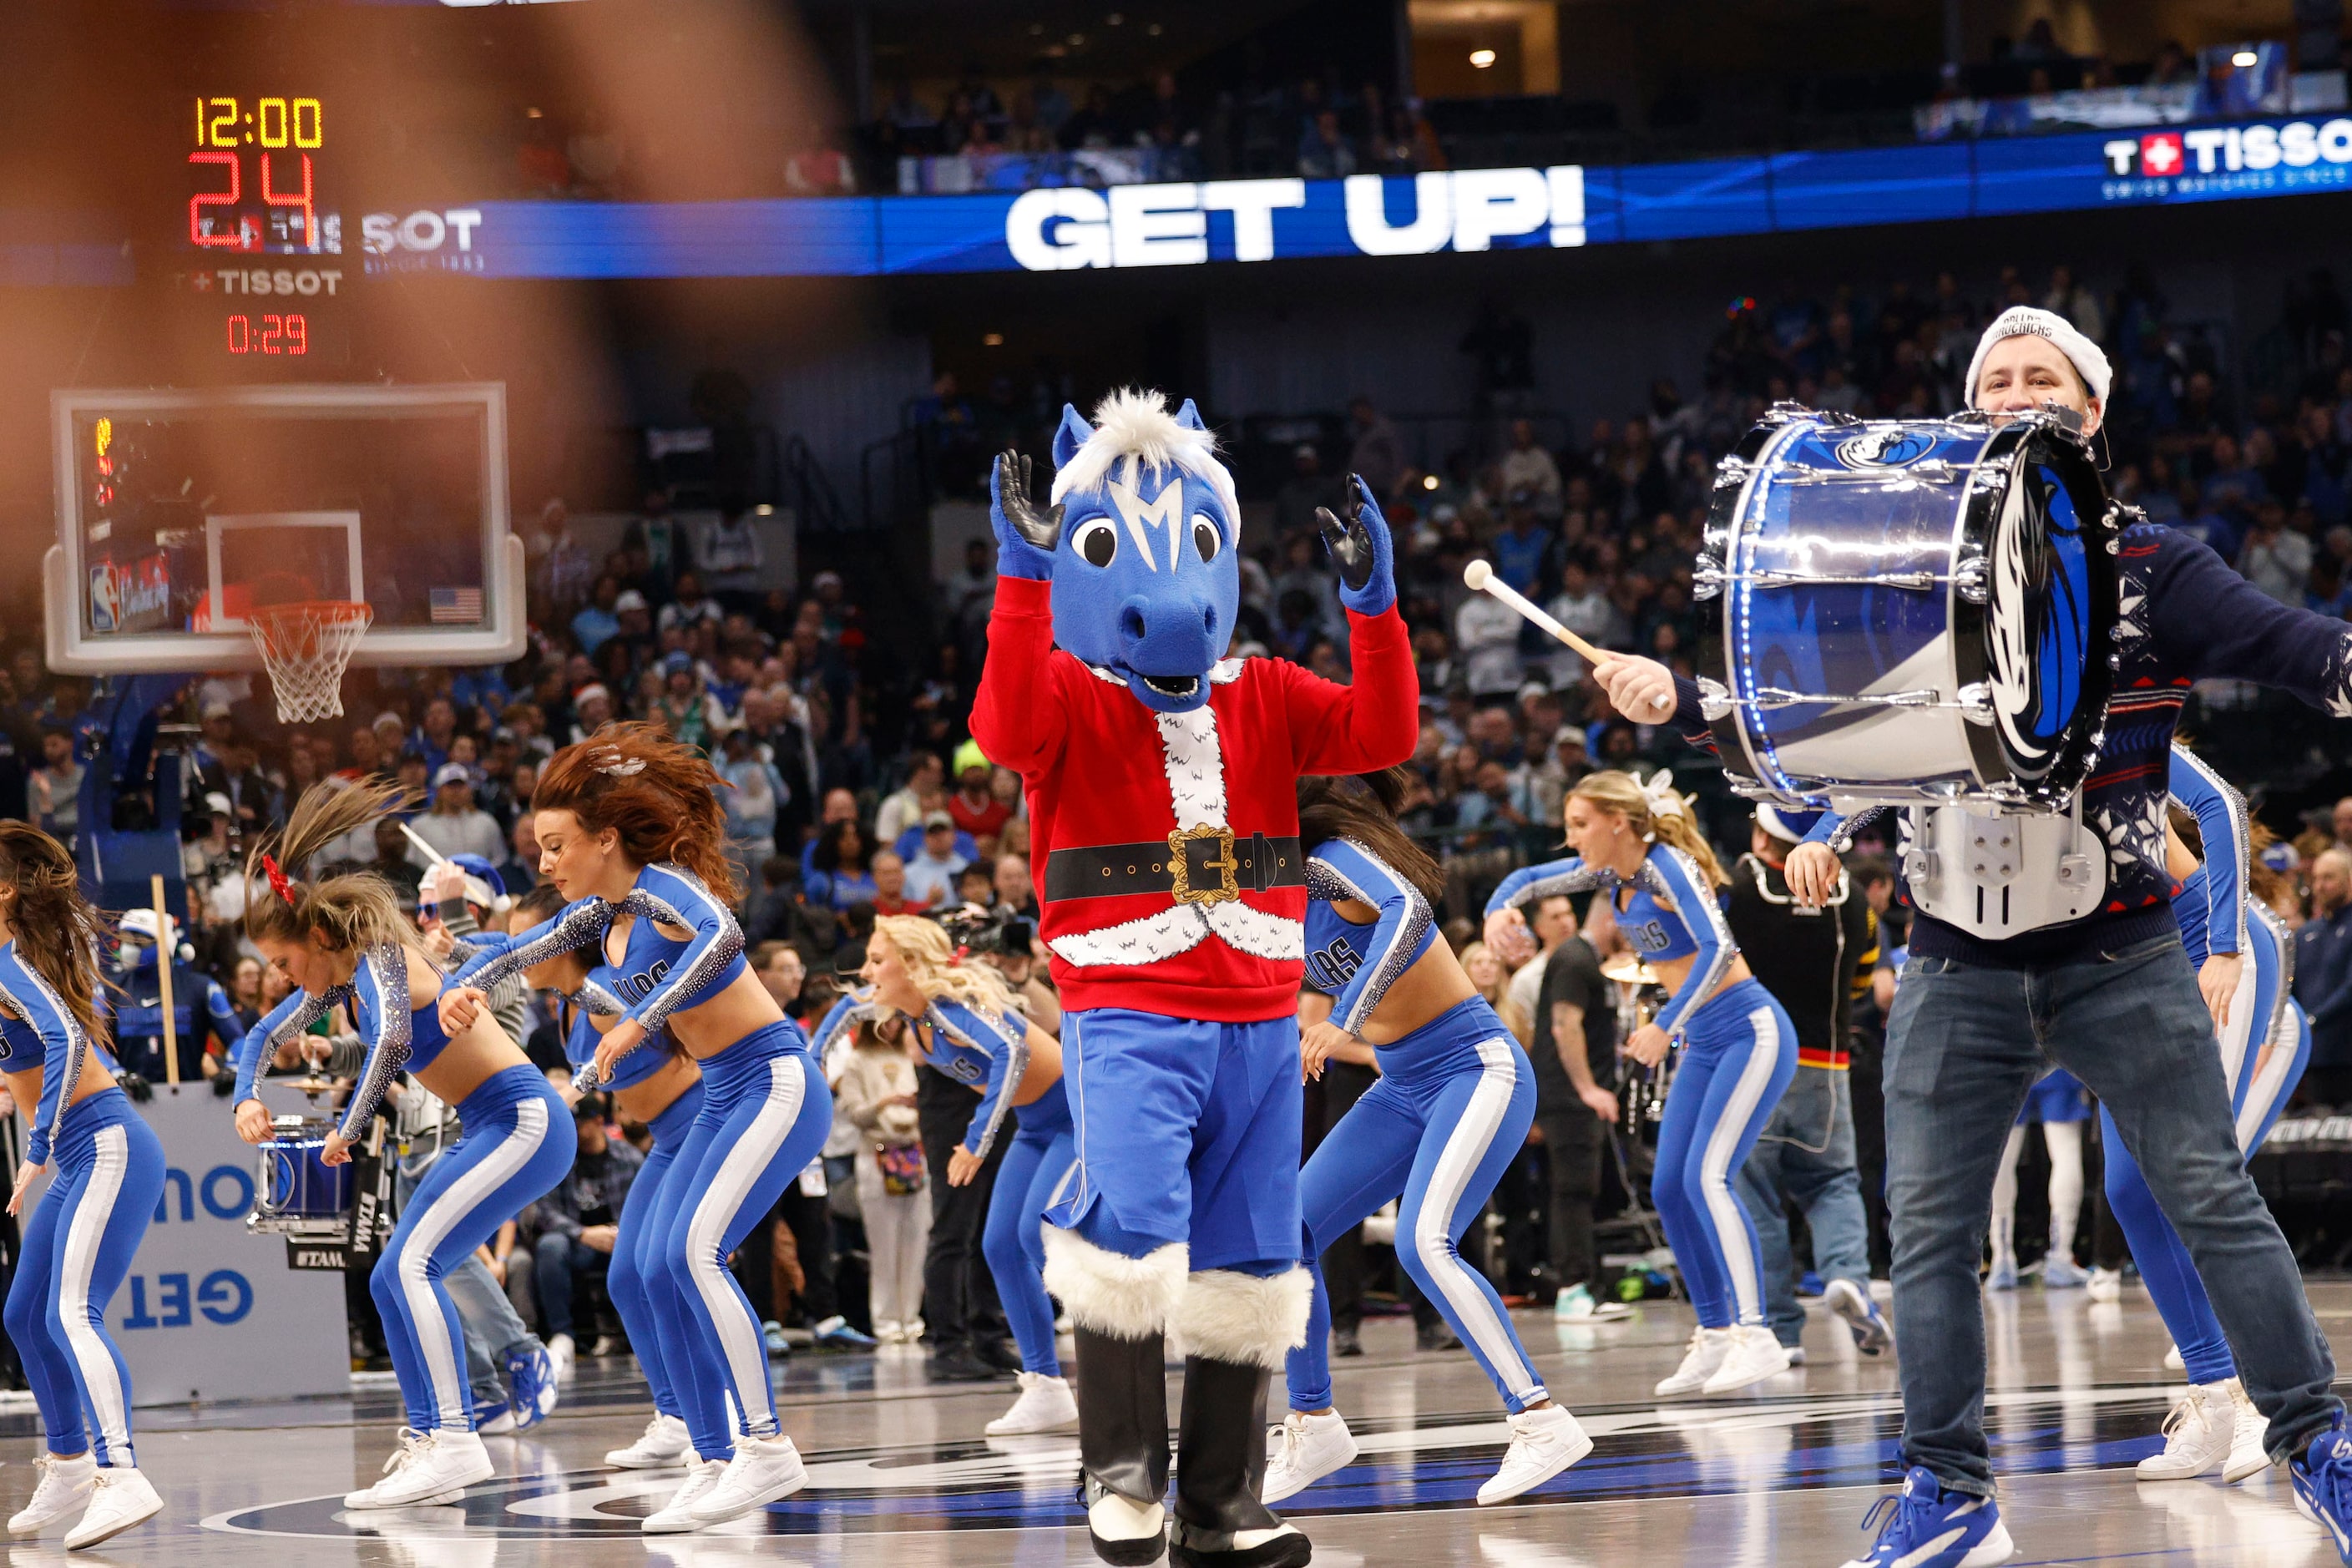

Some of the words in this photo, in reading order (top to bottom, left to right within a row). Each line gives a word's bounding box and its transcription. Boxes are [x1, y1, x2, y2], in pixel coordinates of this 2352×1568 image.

[197, 97, 322, 149] 12:00
[189, 152, 313, 247] 24
[1005, 177, 1305, 271] GET
[1345, 164, 1586, 256] UP!
[216, 269, 342, 296] TISSOT
[227, 314, 307, 355] 0:29
[153, 1165, 255, 1223] OU
[307, 1251, 349, 1267] TAM
[123, 1269, 254, 1329] GET
